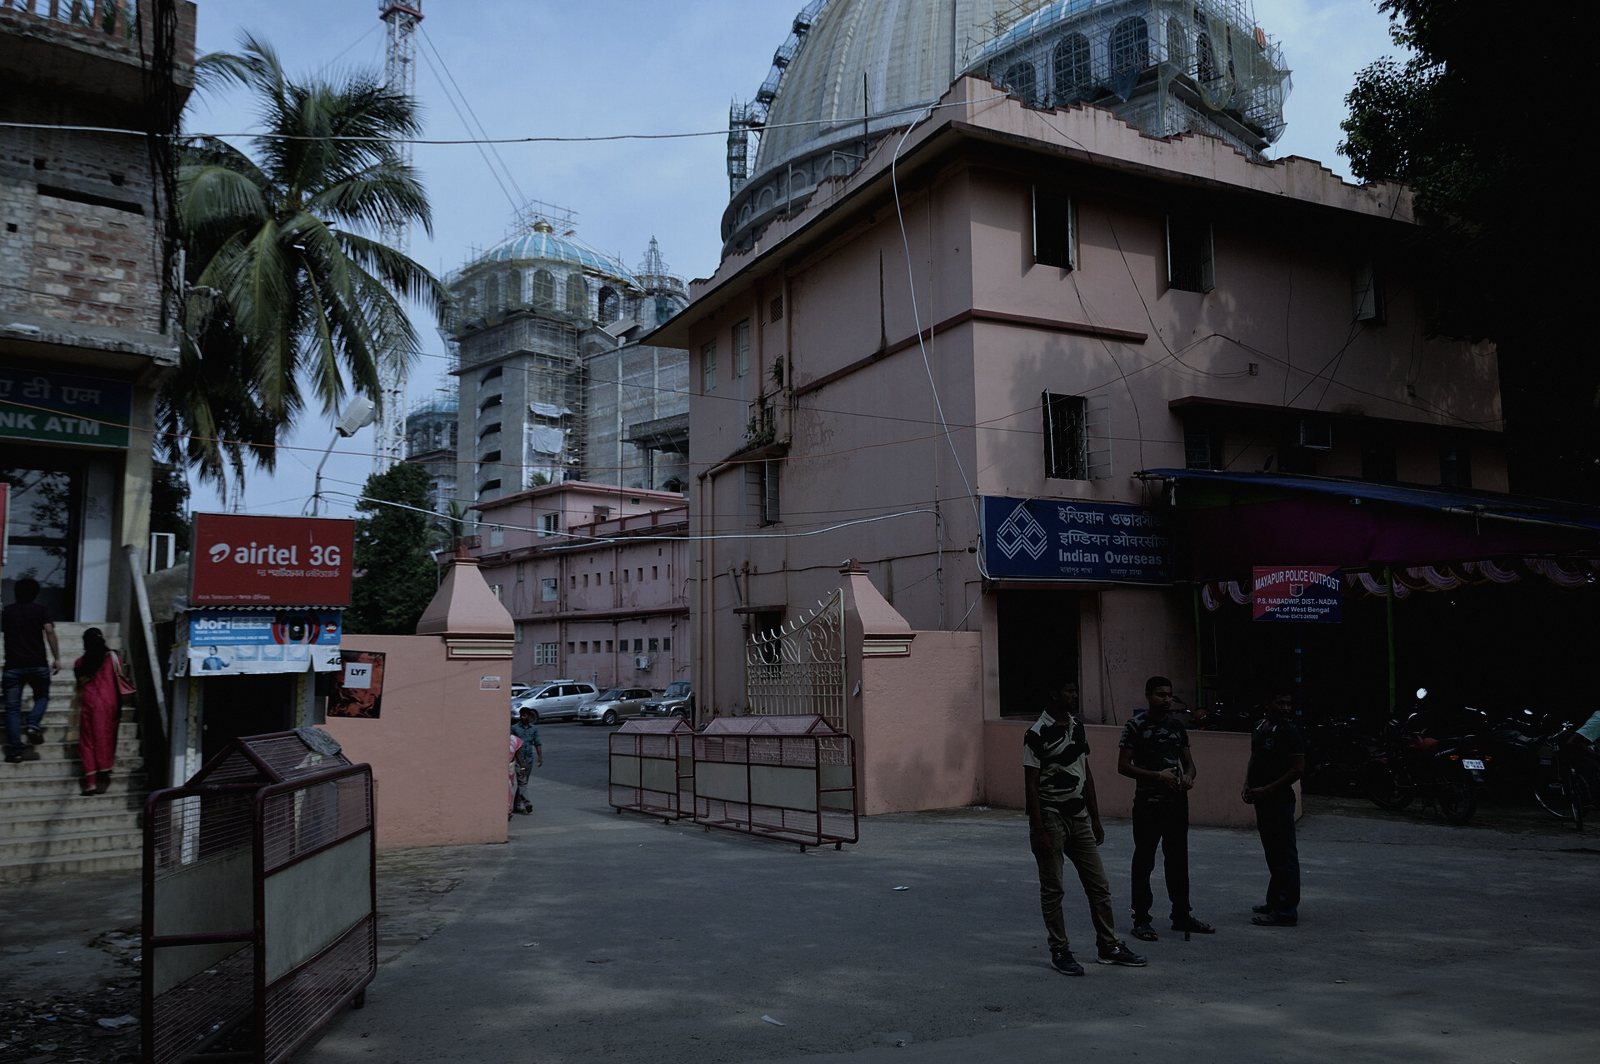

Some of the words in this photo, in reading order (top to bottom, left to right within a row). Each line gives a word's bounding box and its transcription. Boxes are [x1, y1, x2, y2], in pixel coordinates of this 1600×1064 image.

[22, 376, 52, 400] टी
[60, 385, 103, 405] एम
[43, 416, 100, 436] ATM
[1109, 509, 1160, 528] ওভারসী
[234, 541, 299, 566] airtel
[308, 545, 341, 567] 3G
[1058, 548, 1099, 563] Indian
[1104, 550, 1163, 566] Overseas
[1255, 571, 1284, 592] MAYAPUR
[1285, 569, 1308, 582] POLICE
[1309, 571, 1340, 592] OUTPOST
[350, 668, 367, 676] LYF
